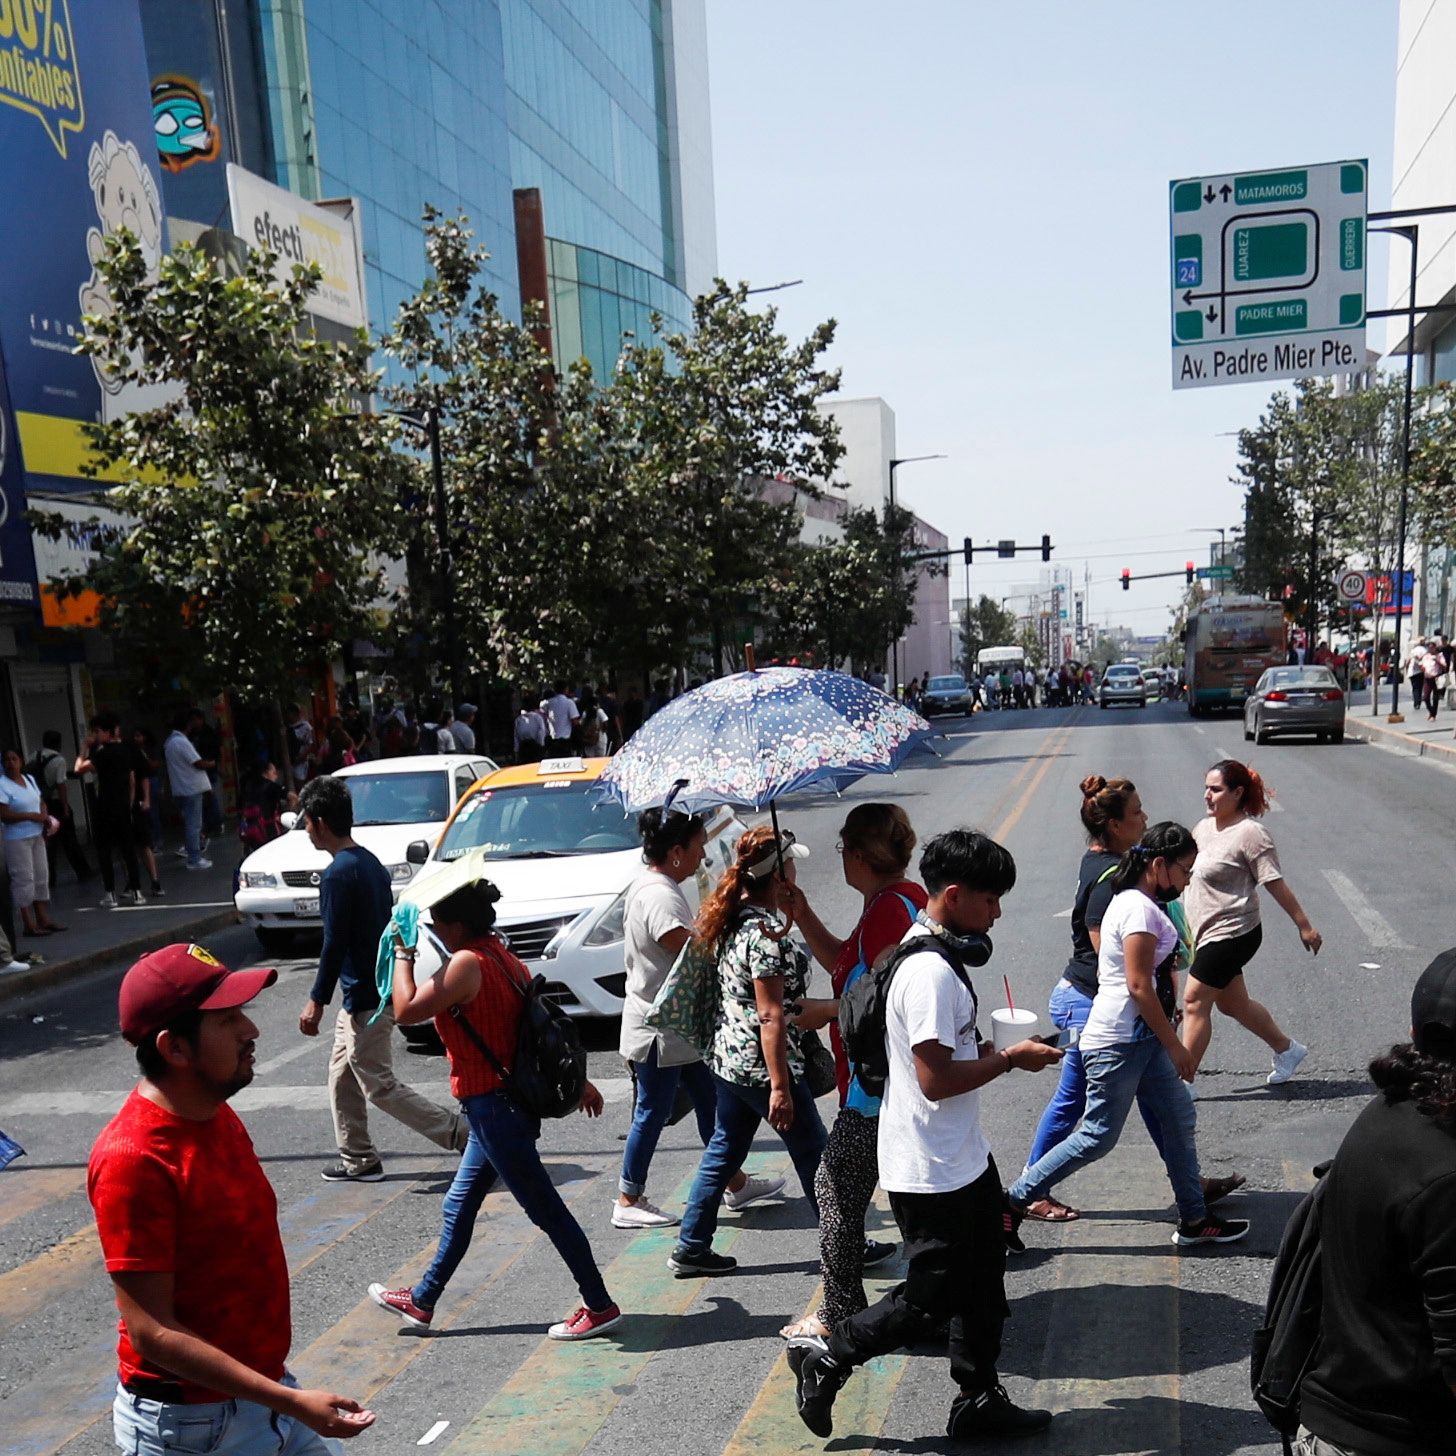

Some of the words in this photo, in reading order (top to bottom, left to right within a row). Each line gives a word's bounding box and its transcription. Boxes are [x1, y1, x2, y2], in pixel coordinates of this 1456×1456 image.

[1238, 182, 1304, 200] MATAMOROS
[1345, 220, 1356, 268] GUERRERO
[1238, 230, 1249, 278] JUAREZ
[1179, 267, 1197, 283] 24
[1239, 308, 1274, 321] PADRE
[1276, 304, 1303, 317] MIER
[1180, 354, 1207, 381] Av.
[1213, 348, 1268, 378] Padre
[1274, 343, 1316, 372] Mier
[1321, 339, 1357, 367] Pte.
[1346, 577, 1361, 589] 40
